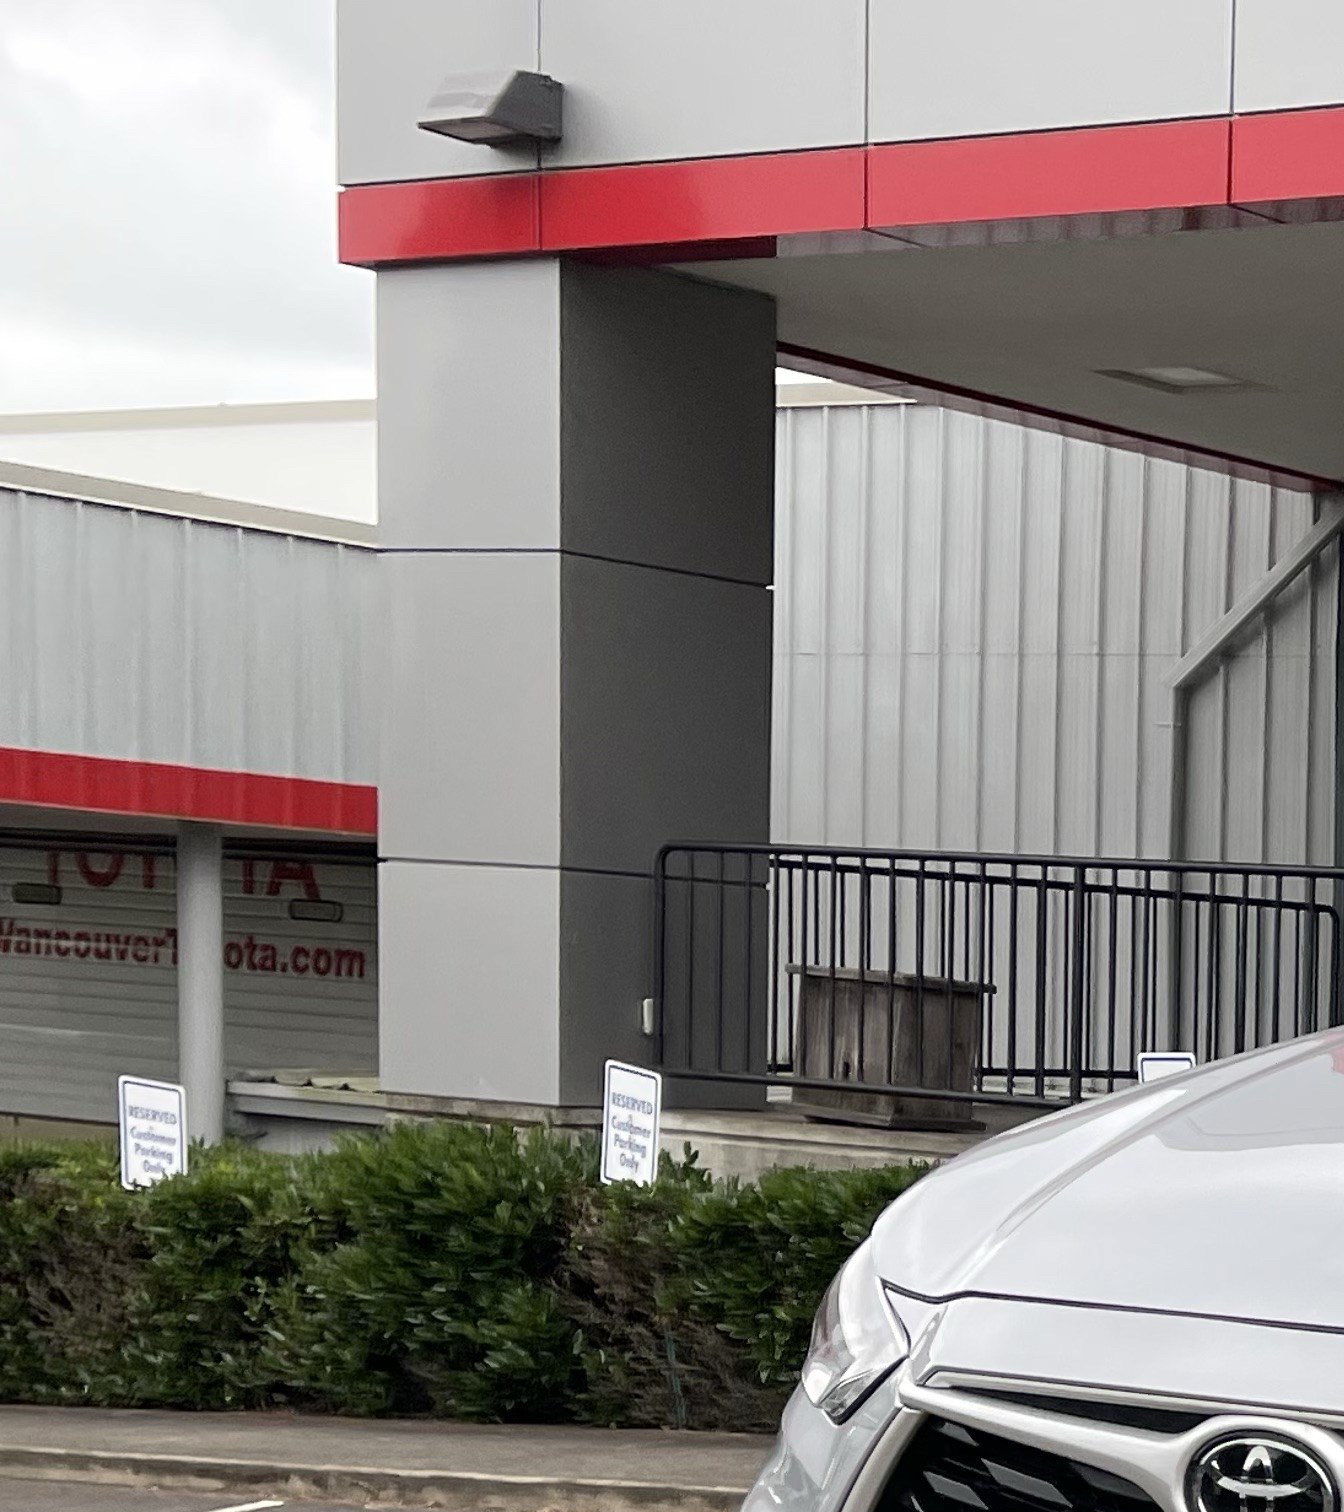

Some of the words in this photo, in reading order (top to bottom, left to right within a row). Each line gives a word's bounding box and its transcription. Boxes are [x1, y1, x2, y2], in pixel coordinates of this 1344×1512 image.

[44, 849, 323, 901] TOYTA
[0, 919, 366, 979] VancouverTota.com
[128, 1105, 177, 1125] RESERVED
[612, 1092, 653, 1115] RESERVED
[612, 1115, 651, 1138] Customer
[134, 1143, 173, 1165] Parking
[614, 1134, 646, 1159] Parking
[620, 1153, 639, 1173] Only
